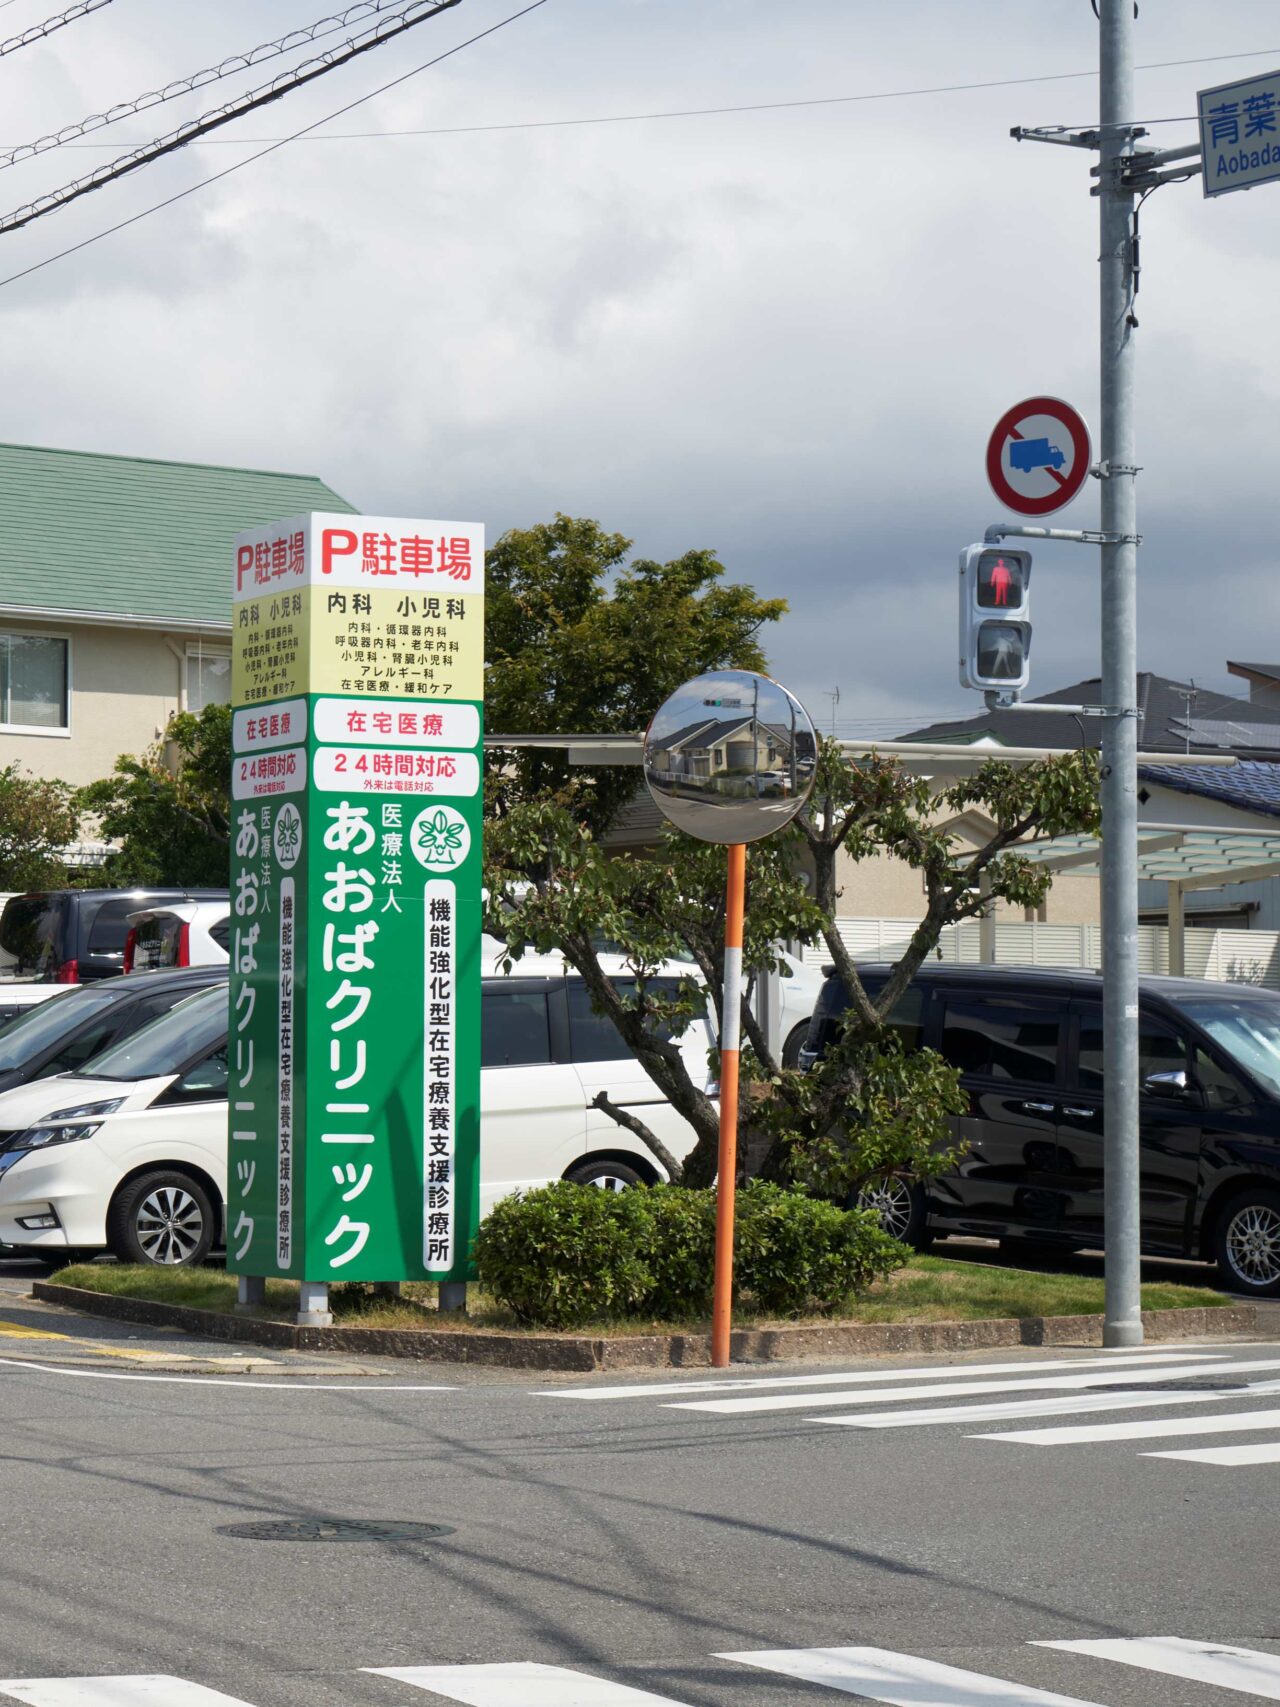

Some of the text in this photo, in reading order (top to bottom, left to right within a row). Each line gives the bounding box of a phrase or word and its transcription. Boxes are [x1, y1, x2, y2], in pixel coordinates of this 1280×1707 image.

[1207, 92, 1280, 149] 青葉
[237, 531, 305, 592] P駐車場
[321, 528, 471, 581] P駐車場
[240, 593, 302, 628] 内科 小児科
[327, 592, 466, 620] 内科 小児科
[335, 636, 459, 652] 呼吸器内科・老年内科
[348, 622, 447, 637] 内科・循環器内科
[341, 651, 453, 666] 小児科・腎臓小児科
[361, 666, 434, 679] アレルギー科
[254, 668, 287, 685] アレルギー科
[341, 679, 453, 695] 在宅医療・緩和ケア
[247, 712, 290, 741] 在宅医療
[347, 711, 444, 736] 在宅医療
[241, 752, 296, 781] 24時間対応
[334, 753, 456, 778] 24時間対応
[363, 779, 434, 792] 外来は電話対応
[260, 806, 271, 913] 医療法人
[381, 803, 402, 913] 医療法人
[233, 808, 260, 1261] あおばクリニック
[321, 800, 379, 1268] あおばクリニック
[279, 896, 293, 1260] 機能強化型在宅療養支援診療所
[428, 898, 451, 1262] 機能強化型在宅療養支援診療所
